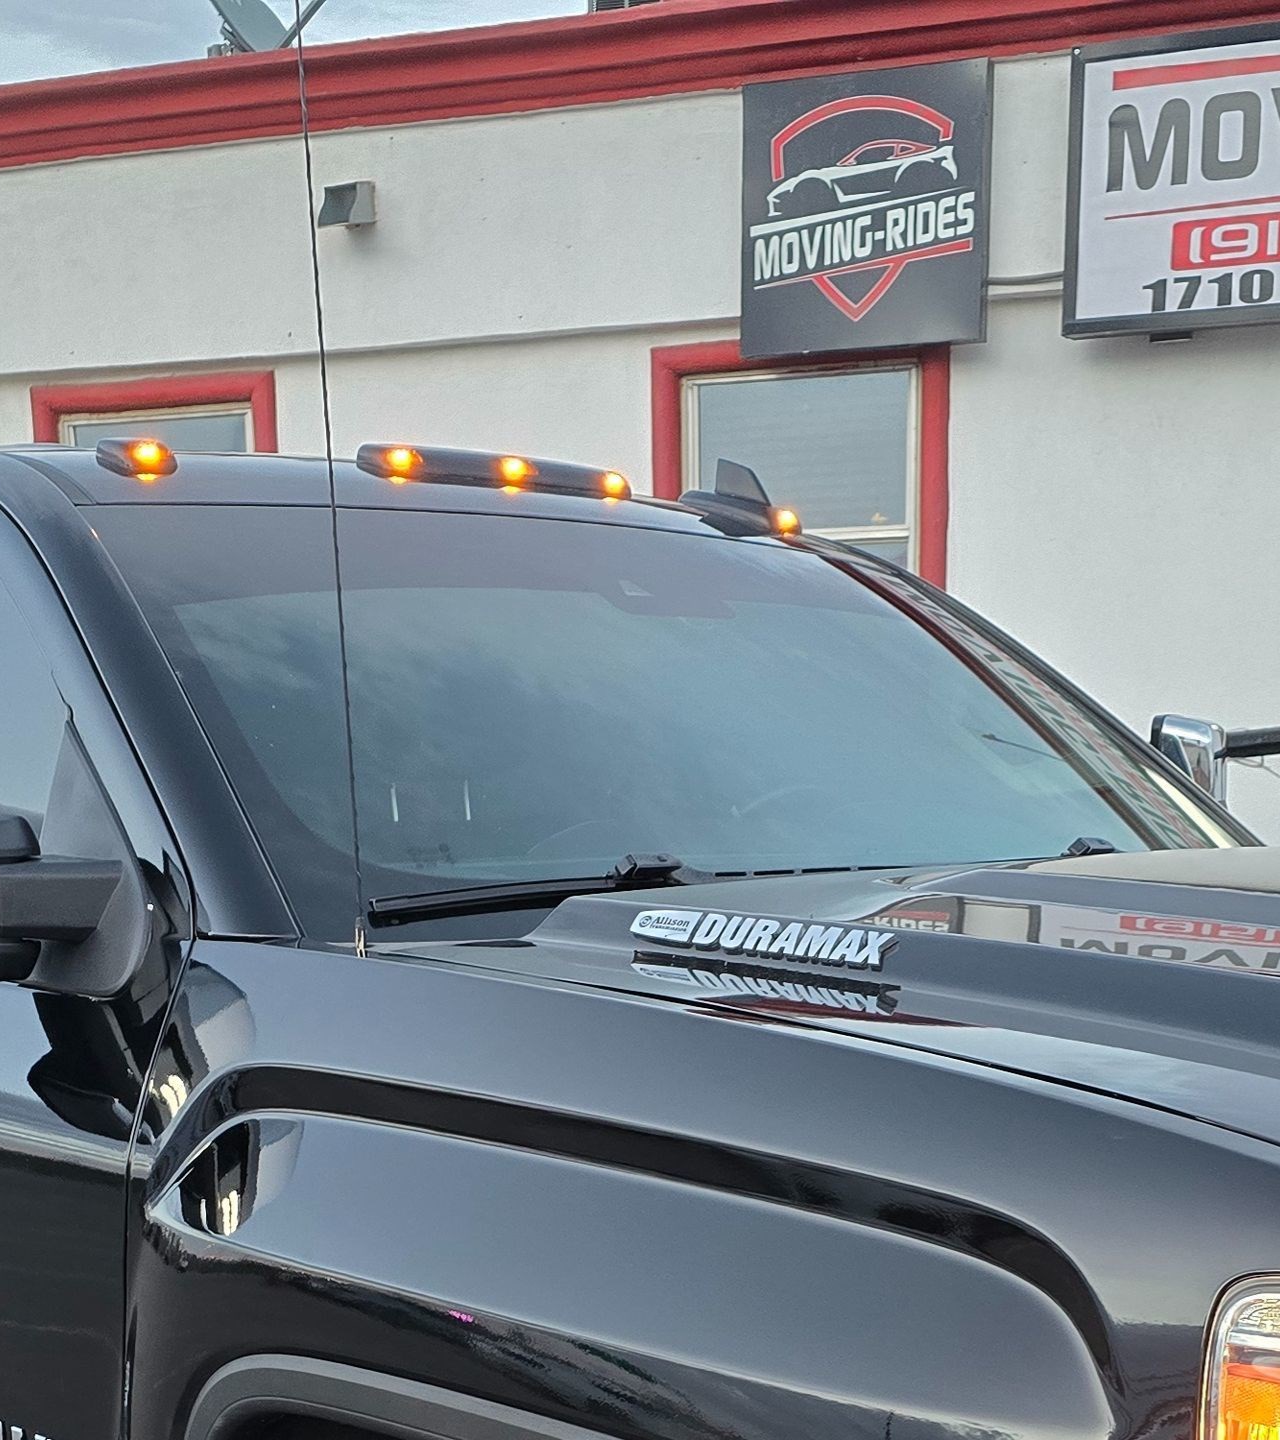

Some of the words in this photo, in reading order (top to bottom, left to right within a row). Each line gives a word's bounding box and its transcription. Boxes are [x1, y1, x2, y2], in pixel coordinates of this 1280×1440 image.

[753, 191, 976, 282] MOVING-RIDES
[1142, 269, 1275, 313] 1710
[653, 916, 691, 928] Allison
[691, 913, 896, 967] DURAMAX
